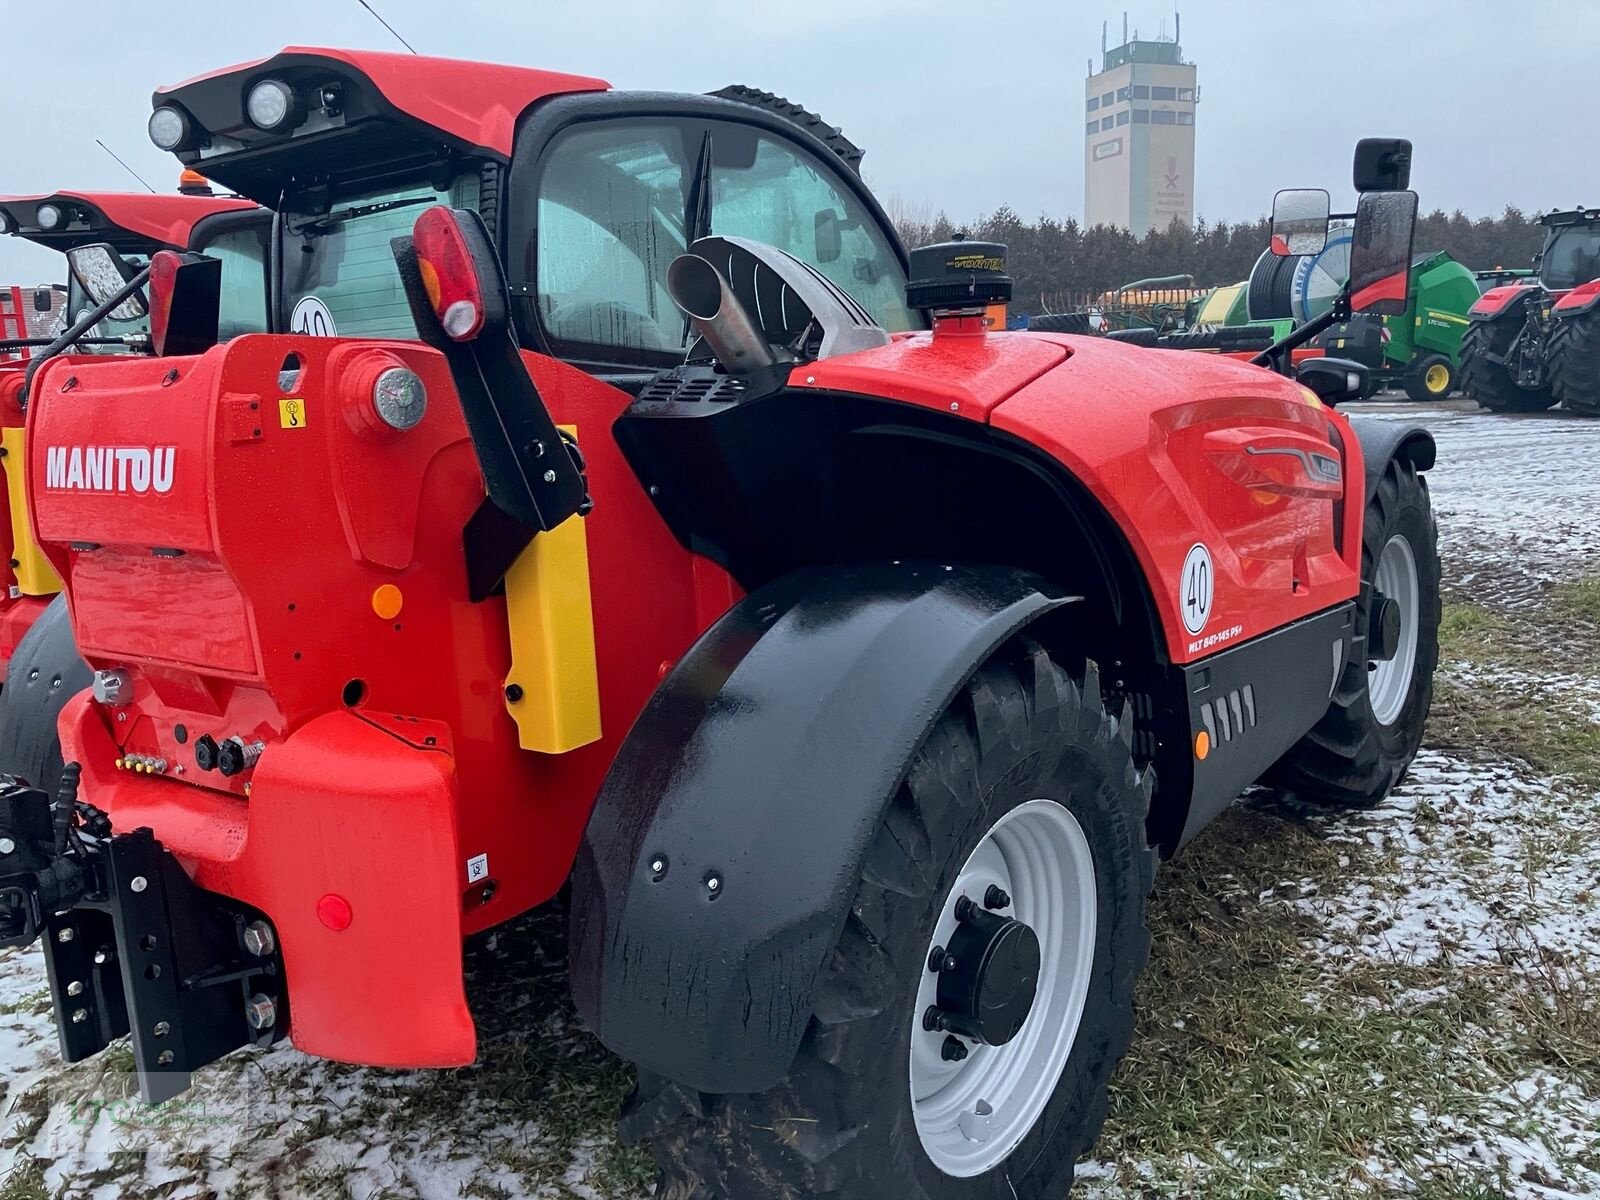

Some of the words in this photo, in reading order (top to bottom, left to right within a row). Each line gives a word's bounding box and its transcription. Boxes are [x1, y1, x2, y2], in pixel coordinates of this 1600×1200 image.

[46, 447, 176, 493] MANITOU
[1187, 560, 1207, 618] 40
[1188, 639, 1204, 655] MLT
[1203, 629, 1230, 649] 841-145
